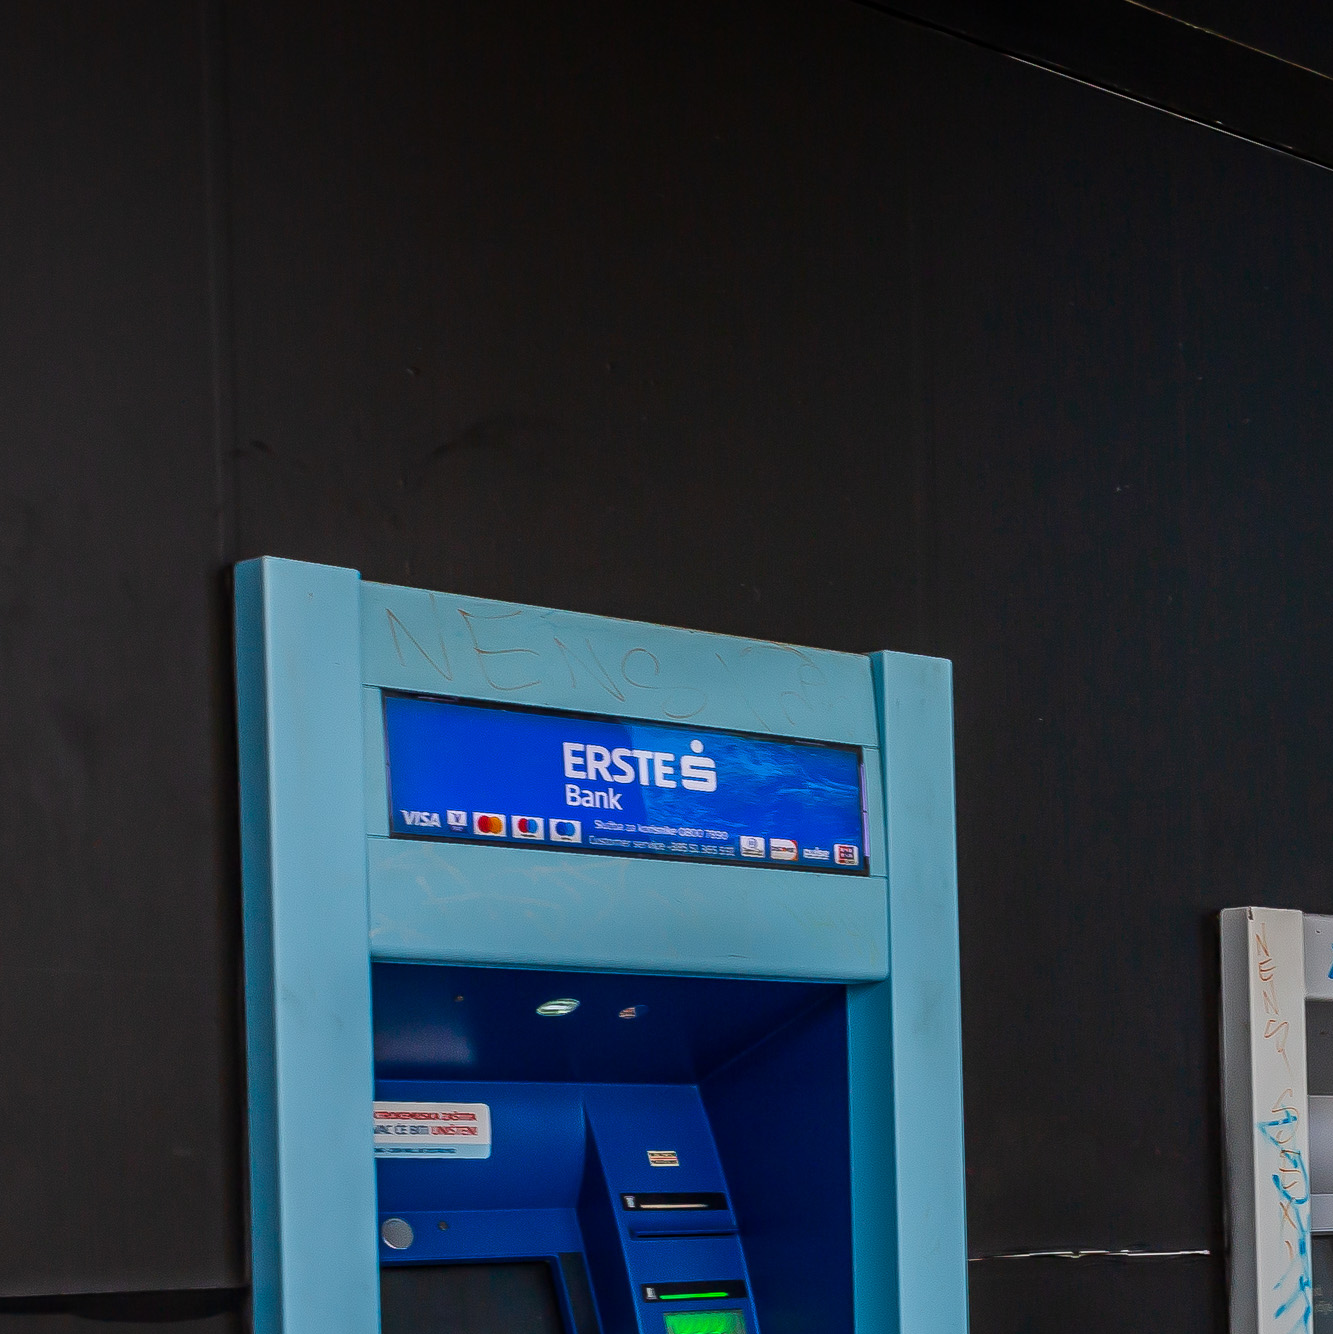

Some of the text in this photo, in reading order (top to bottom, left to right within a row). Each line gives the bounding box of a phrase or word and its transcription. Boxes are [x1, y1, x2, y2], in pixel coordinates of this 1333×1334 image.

[563, 742, 677, 789] ERSTE
[565, 784, 624, 810] Bank
[400, 810, 442, 828] VISA
